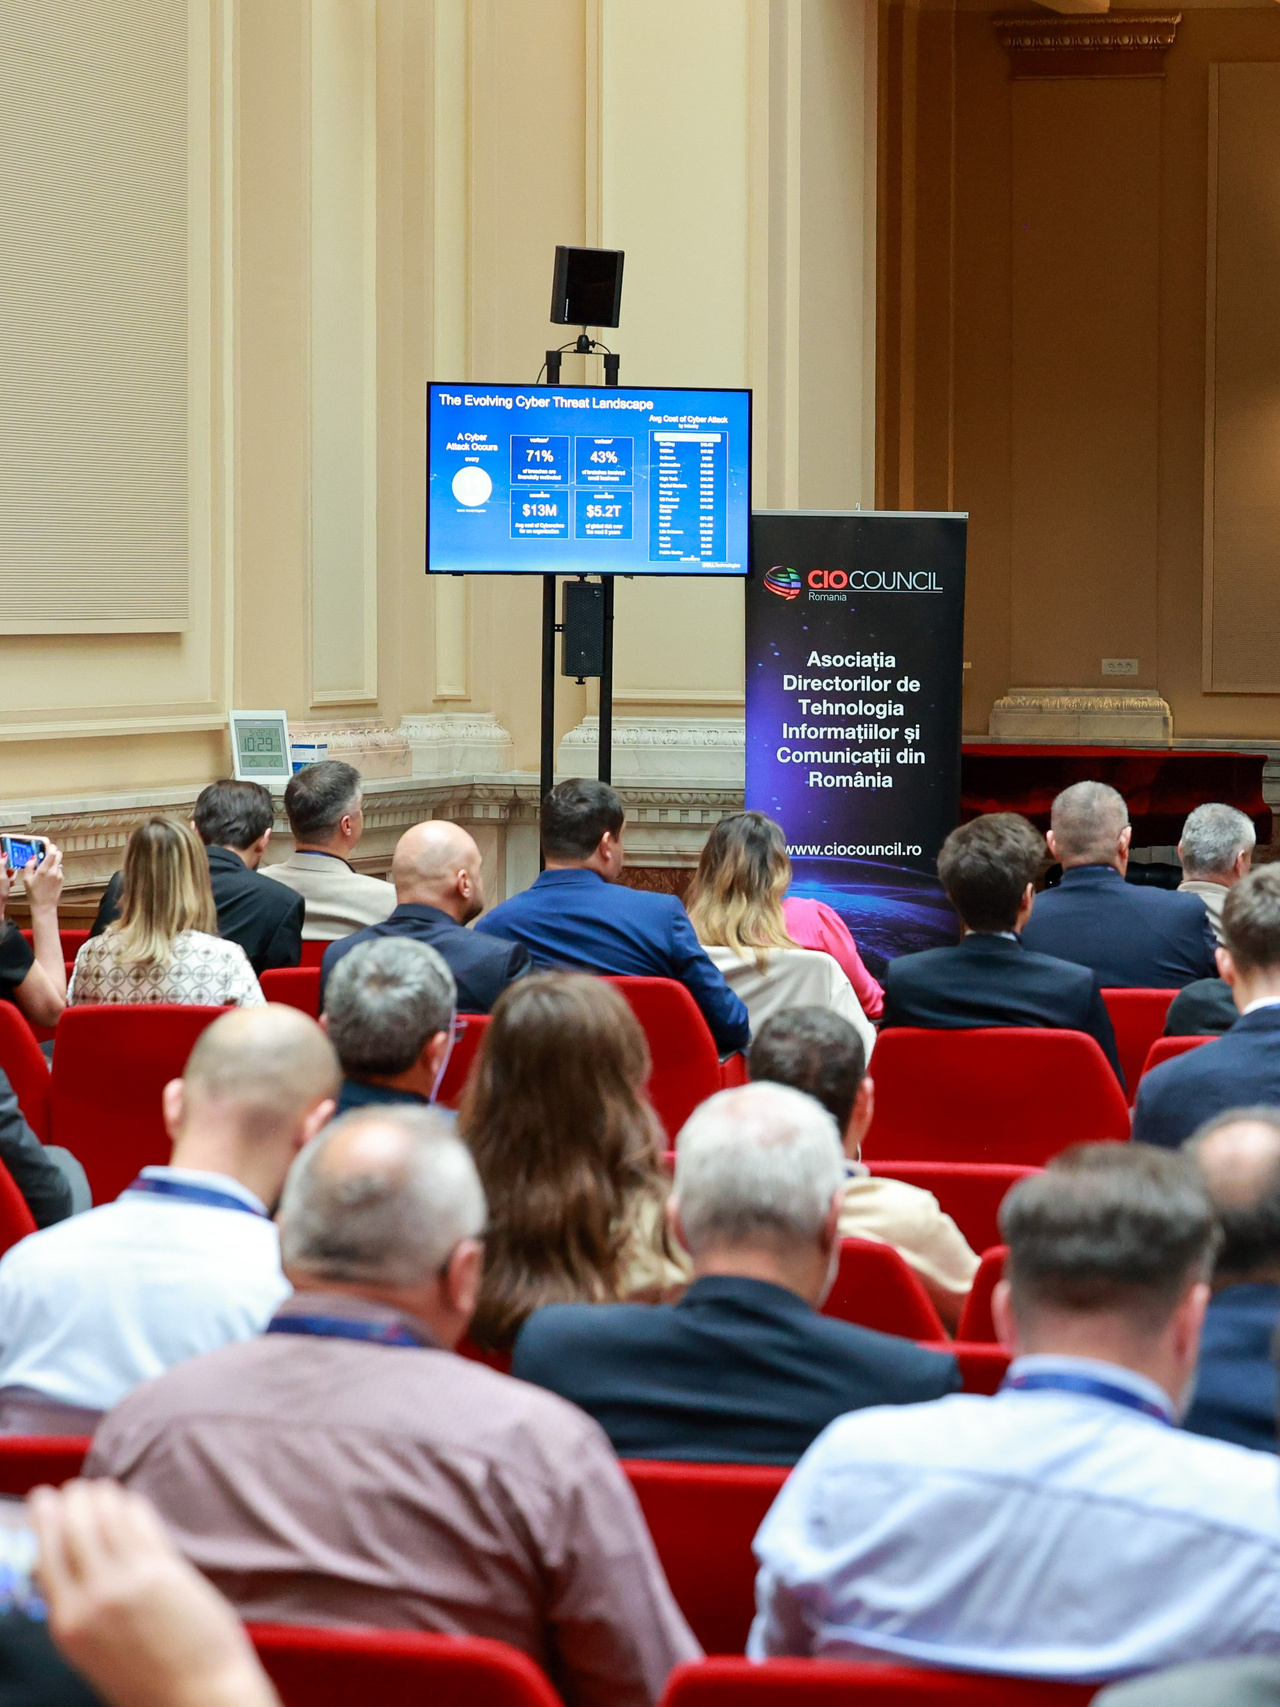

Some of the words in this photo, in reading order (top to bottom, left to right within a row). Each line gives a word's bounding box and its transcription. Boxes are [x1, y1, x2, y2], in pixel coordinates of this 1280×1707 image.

[439, 394, 462, 405] The
[465, 394, 513, 409] Evolving
[516, 396, 550, 410] Cyber
[552, 396, 590, 408] Threat
[592, 398, 654, 412] Landscape
[649, 415, 662, 424] Avg
[663, 415, 679, 423] Cost
[680, 415, 687, 423] of
[688, 416, 706, 424] Cyber
[707, 416, 728, 424] Attack
[464, 433, 488, 442] Cyber
[446, 442, 470, 450] Attack
[471, 443, 498, 451] Occurs
[526, 450, 554, 462] 71%
[590, 451, 618, 463] 43%
[522, 504, 558, 517] $13M
[586, 505, 622, 518] $5.2T
[808, 593, 847, 602] Romania
[807, 651, 895, 671] Asociația
[784, 675, 891, 691] Directorilor
[897, 676, 920, 692] de
[798, 699, 904, 719] Tehnologia
[783, 723, 899, 743] Informațiilor
[904, 724, 919, 744] și
[244, 737, 274, 752] 10:29
[777, 747, 890, 767] Comunicații
[896, 748, 924, 763] din
[808, 772, 893, 788] România
